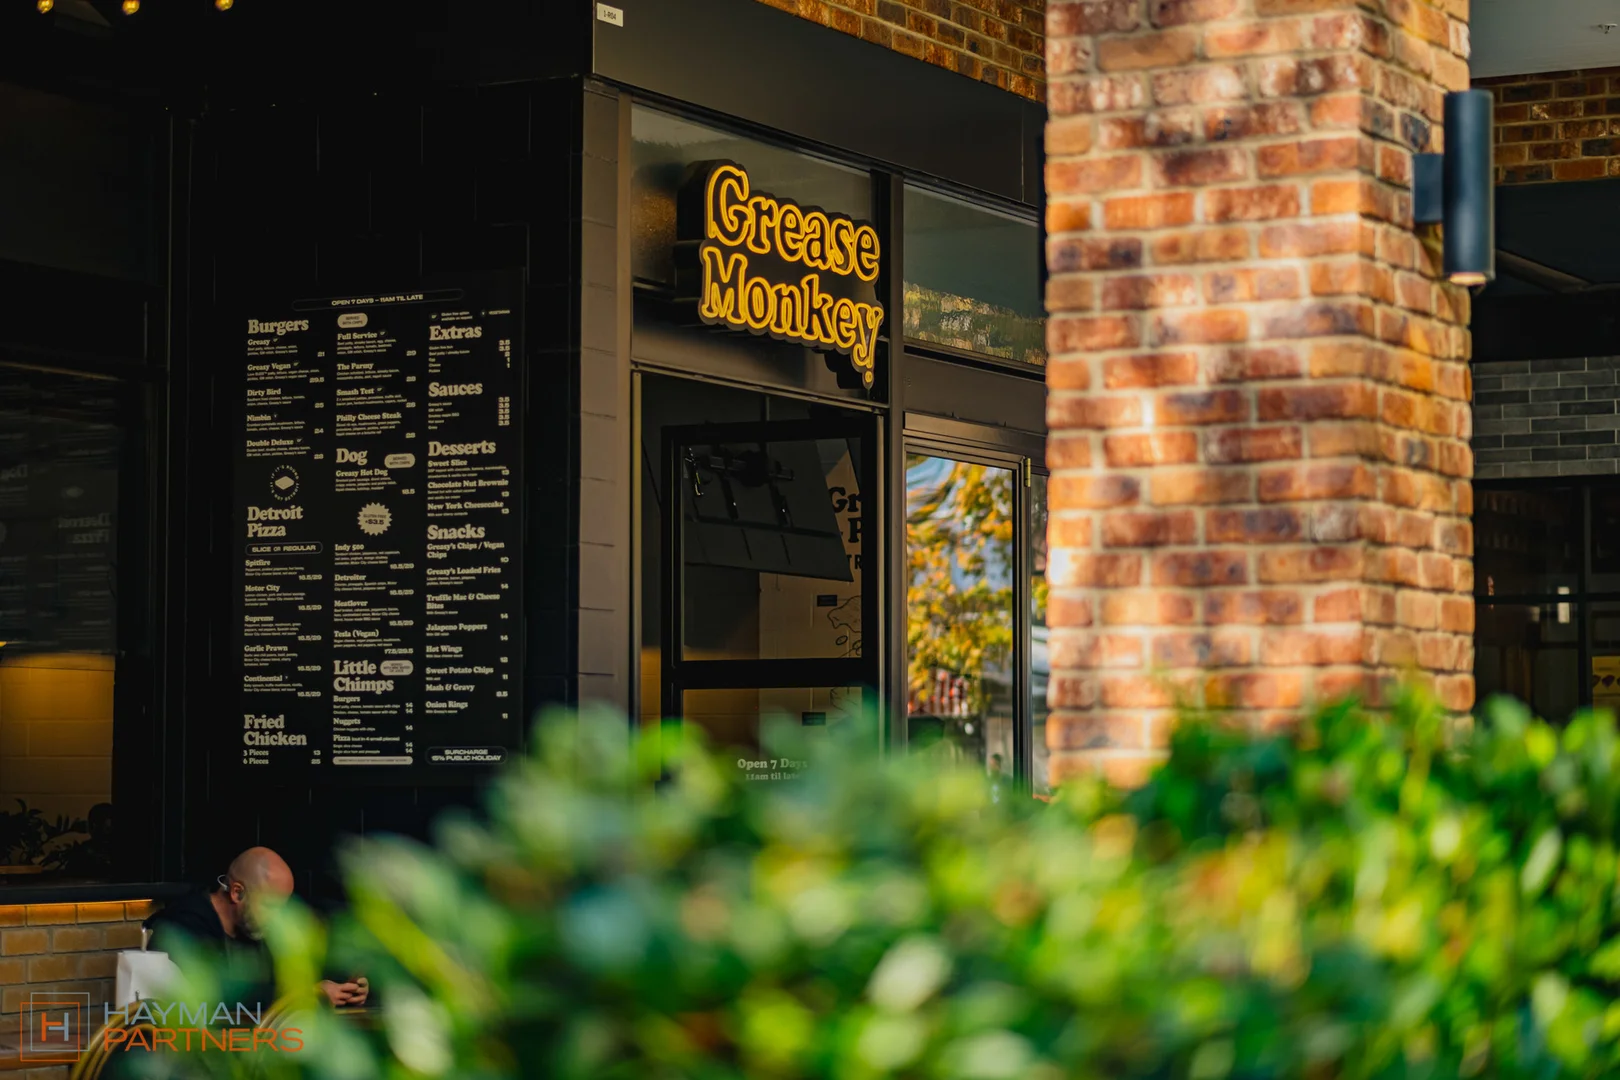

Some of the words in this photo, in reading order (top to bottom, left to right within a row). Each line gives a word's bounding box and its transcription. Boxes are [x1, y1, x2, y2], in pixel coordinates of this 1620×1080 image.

[707, 165, 880, 280] Grease
[702, 247, 883, 374] Monkey
[248, 319, 309, 336] Burgers
[429, 325, 482, 340] Extras
[428, 382, 483, 397] Sauces
[428, 440, 496, 456] Desserts
[336, 448, 368, 465] Dog
[247, 505, 303, 521] Detroit
[247, 523, 286, 537] Pizza
[427, 524, 485, 539] Snacks
[352, 629, 379, 638] (Vegan)
[459, 623, 488, 631] Poppers
[440, 645, 462, 653] Wings
[334, 660, 377, 674] Little
[473, 666, 494, 674] Chips
[334, 677, 394, 694] Chimps
[453, 684, 475, 692] Gravy
[333, 695, 360, 703] Burgers
[448, 701, 468, 709] Rings
[244, 714, 285, 729] Fried
[243, 731, 307, 746] Chicken
[737, 758, 768, 770] Open
[770, 759, 778, 769] 7
[780, 758, 808, 770] Days
